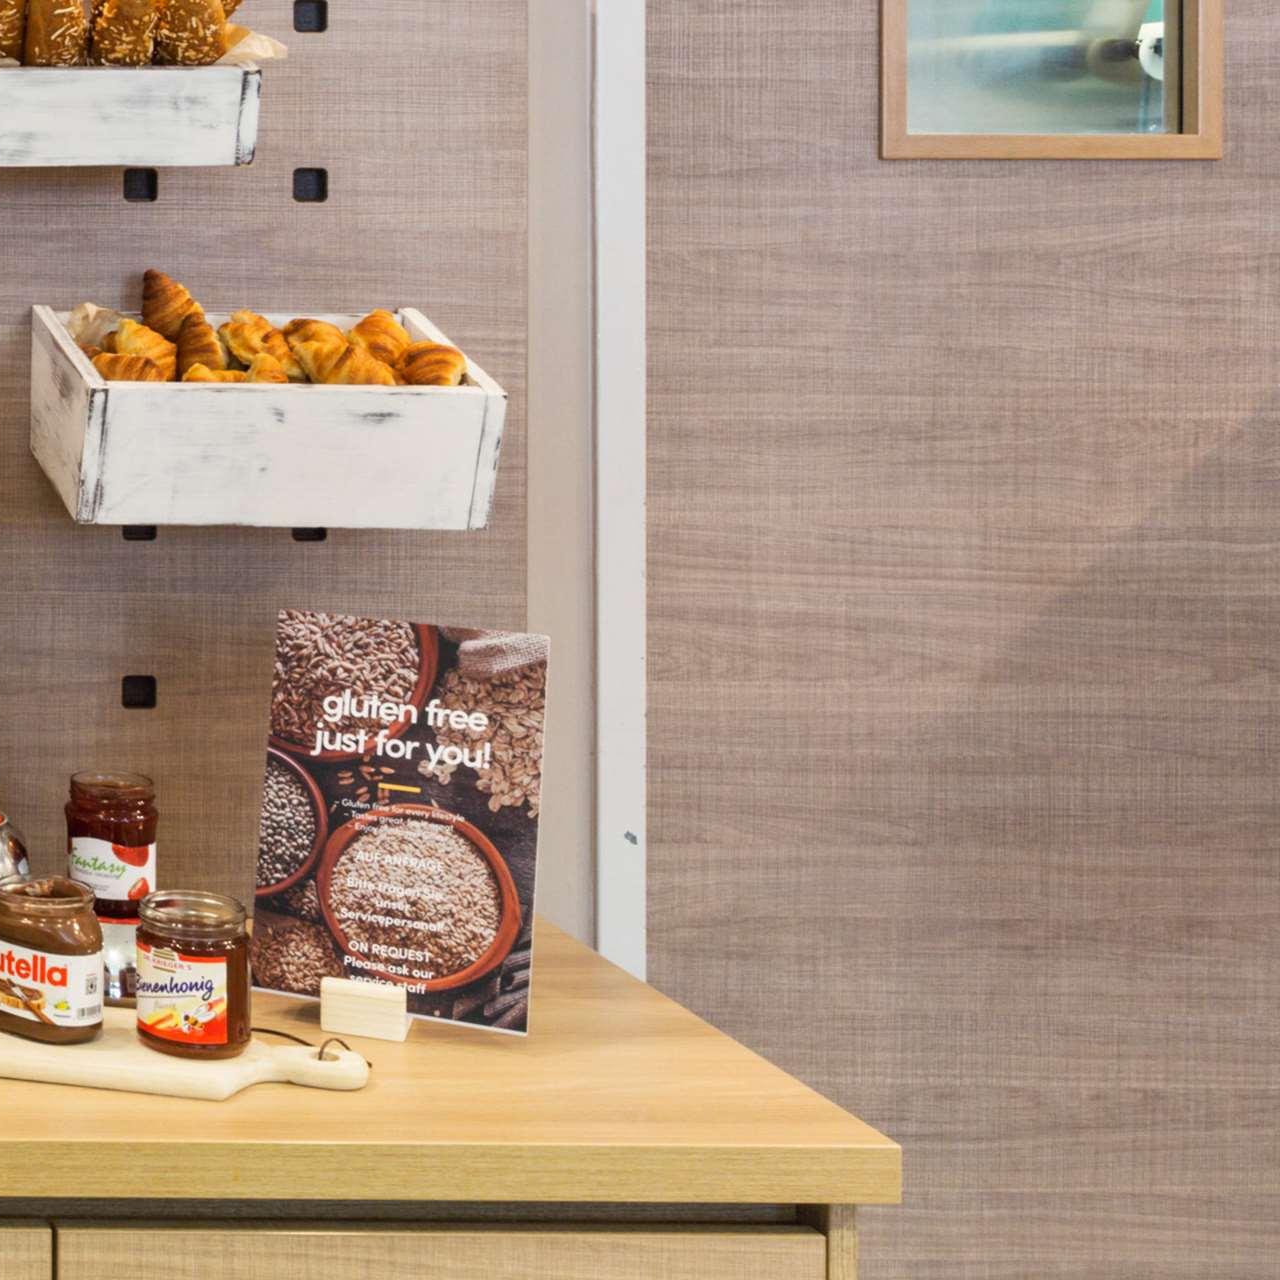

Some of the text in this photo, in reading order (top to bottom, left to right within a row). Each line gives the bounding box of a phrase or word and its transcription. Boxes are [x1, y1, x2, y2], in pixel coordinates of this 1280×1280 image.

[322, 688, 489, 732] gluten free
[310, 722, 491, 770] just for you!
[341, 798, 371, 810] Gluten
[372, 802, 390, 812] free
[348, 940, 433, 963] ON REQUEST
[343, 955, 435, 980] Please ask our
